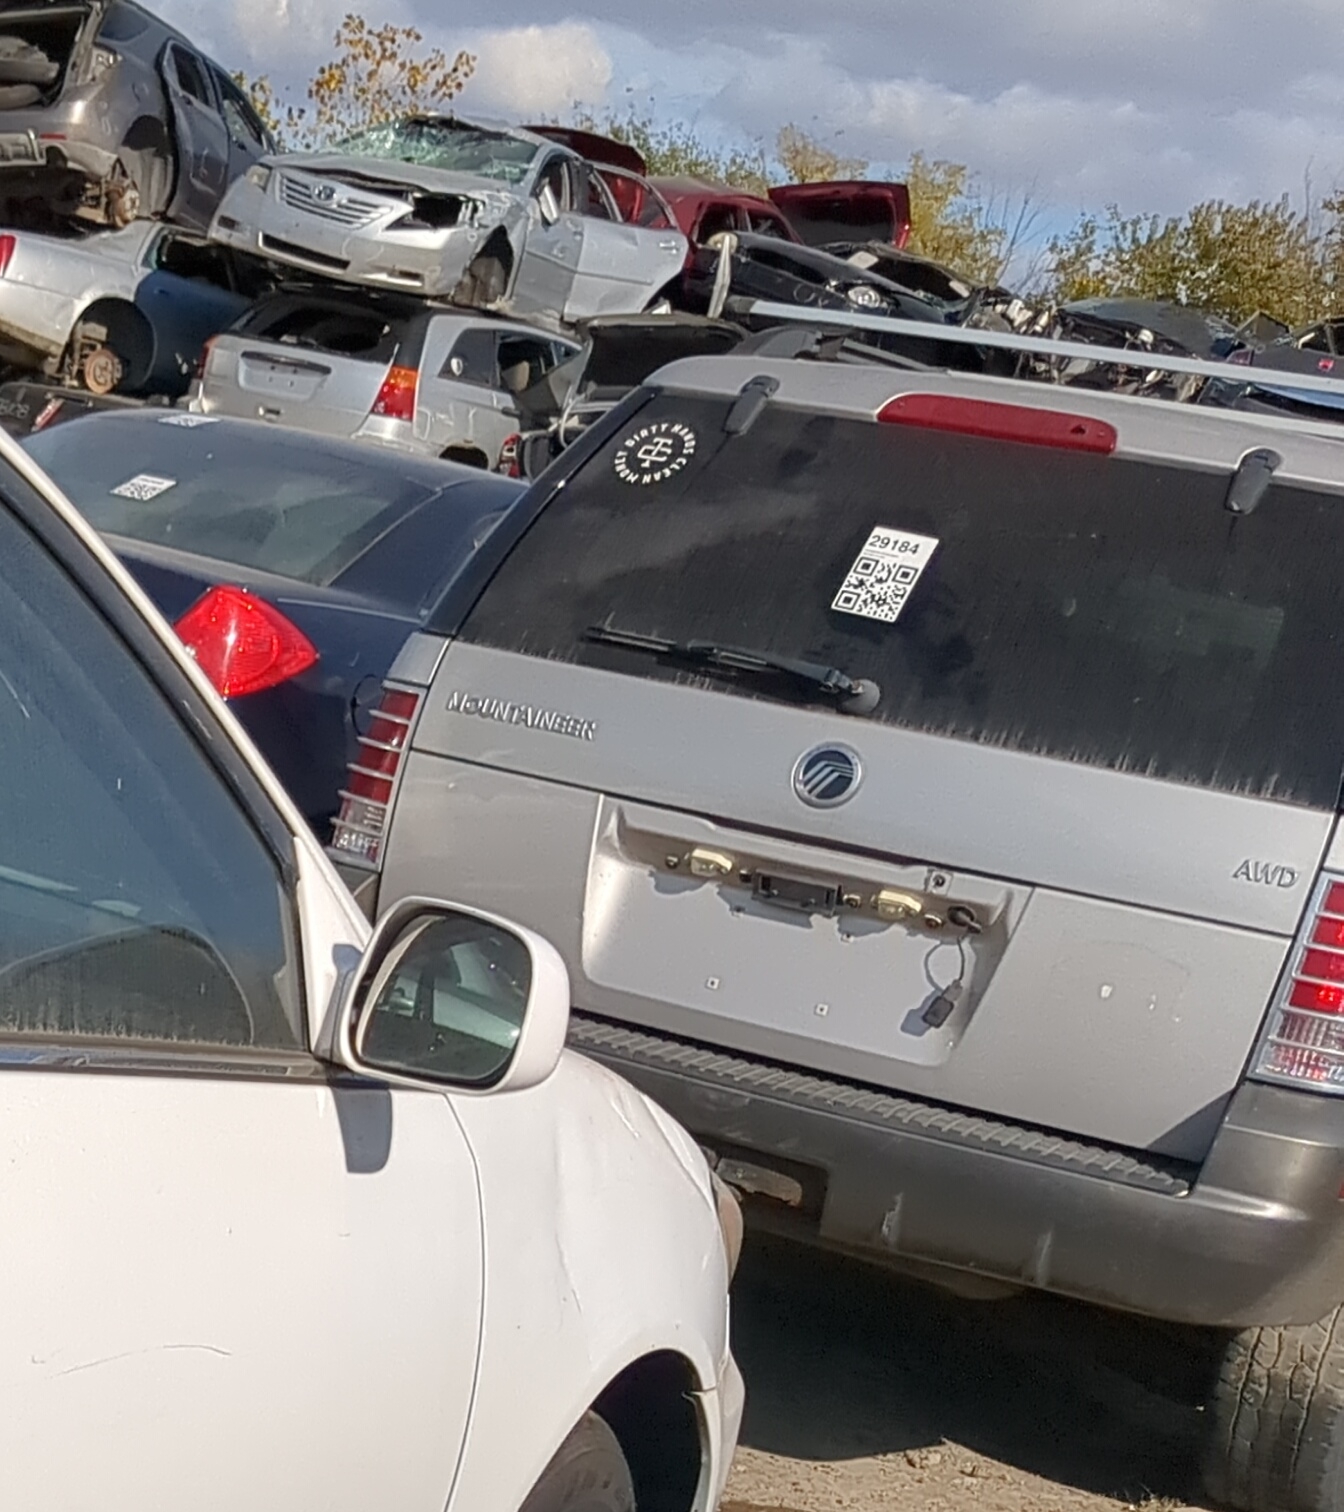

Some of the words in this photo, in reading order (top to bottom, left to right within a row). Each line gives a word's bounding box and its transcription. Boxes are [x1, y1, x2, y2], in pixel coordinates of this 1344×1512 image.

[624, 423, 669, 448] DIRTY
[671, 423, 696, 454] HANDS
[614, 451, 639, 483] MONEY
[642, 457, 687, 484] CLEAN
[868, 534, 920, 555] 29184
[446, 691, 597, 740] MOUNTAINEER
[1232, 859, 1299, 888] AWD
